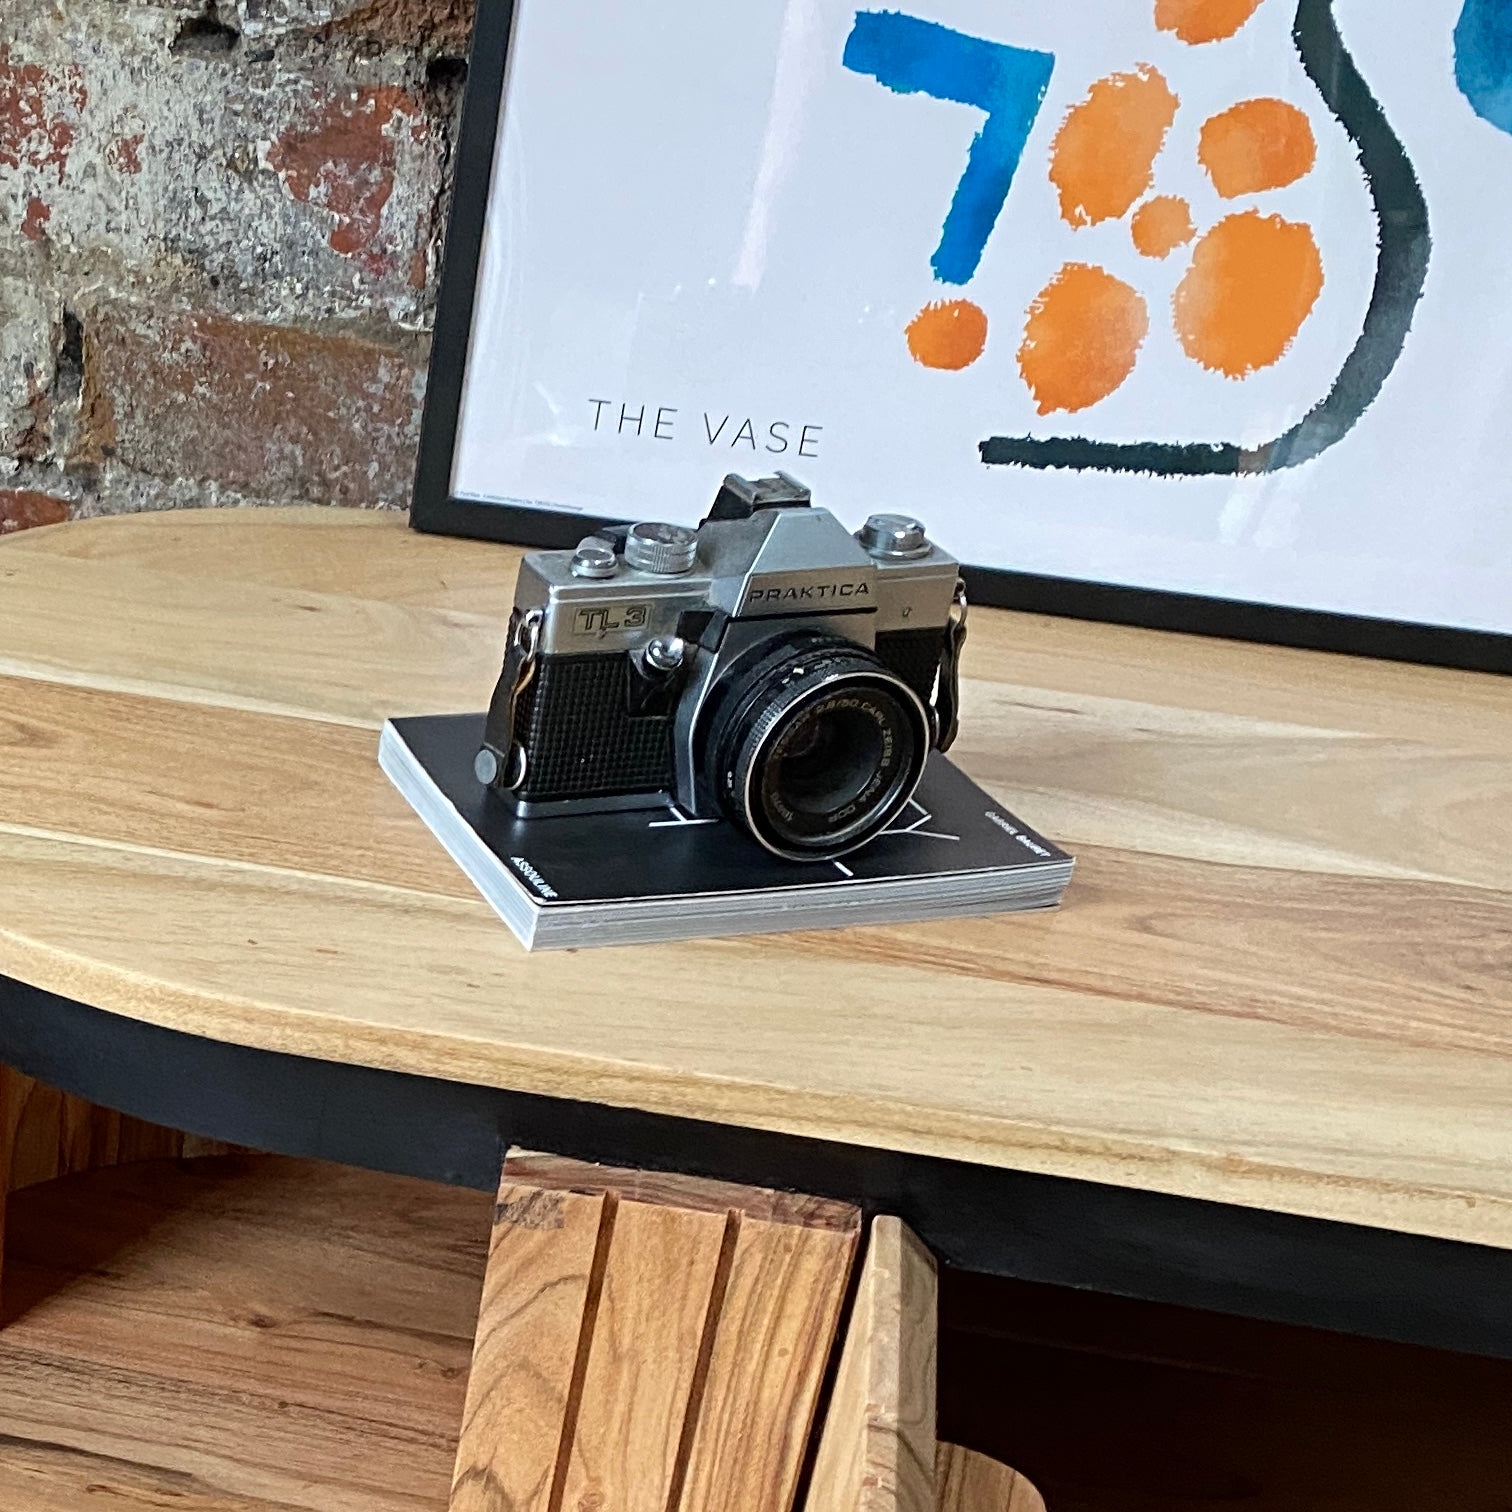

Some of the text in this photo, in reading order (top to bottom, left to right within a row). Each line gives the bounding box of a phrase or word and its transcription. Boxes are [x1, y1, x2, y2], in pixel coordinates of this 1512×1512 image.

[588, 398, 823, 458] THE VASE
[749, 582, 870, 602] PRAKTICA
[860, 701, 887, 727] CARL
